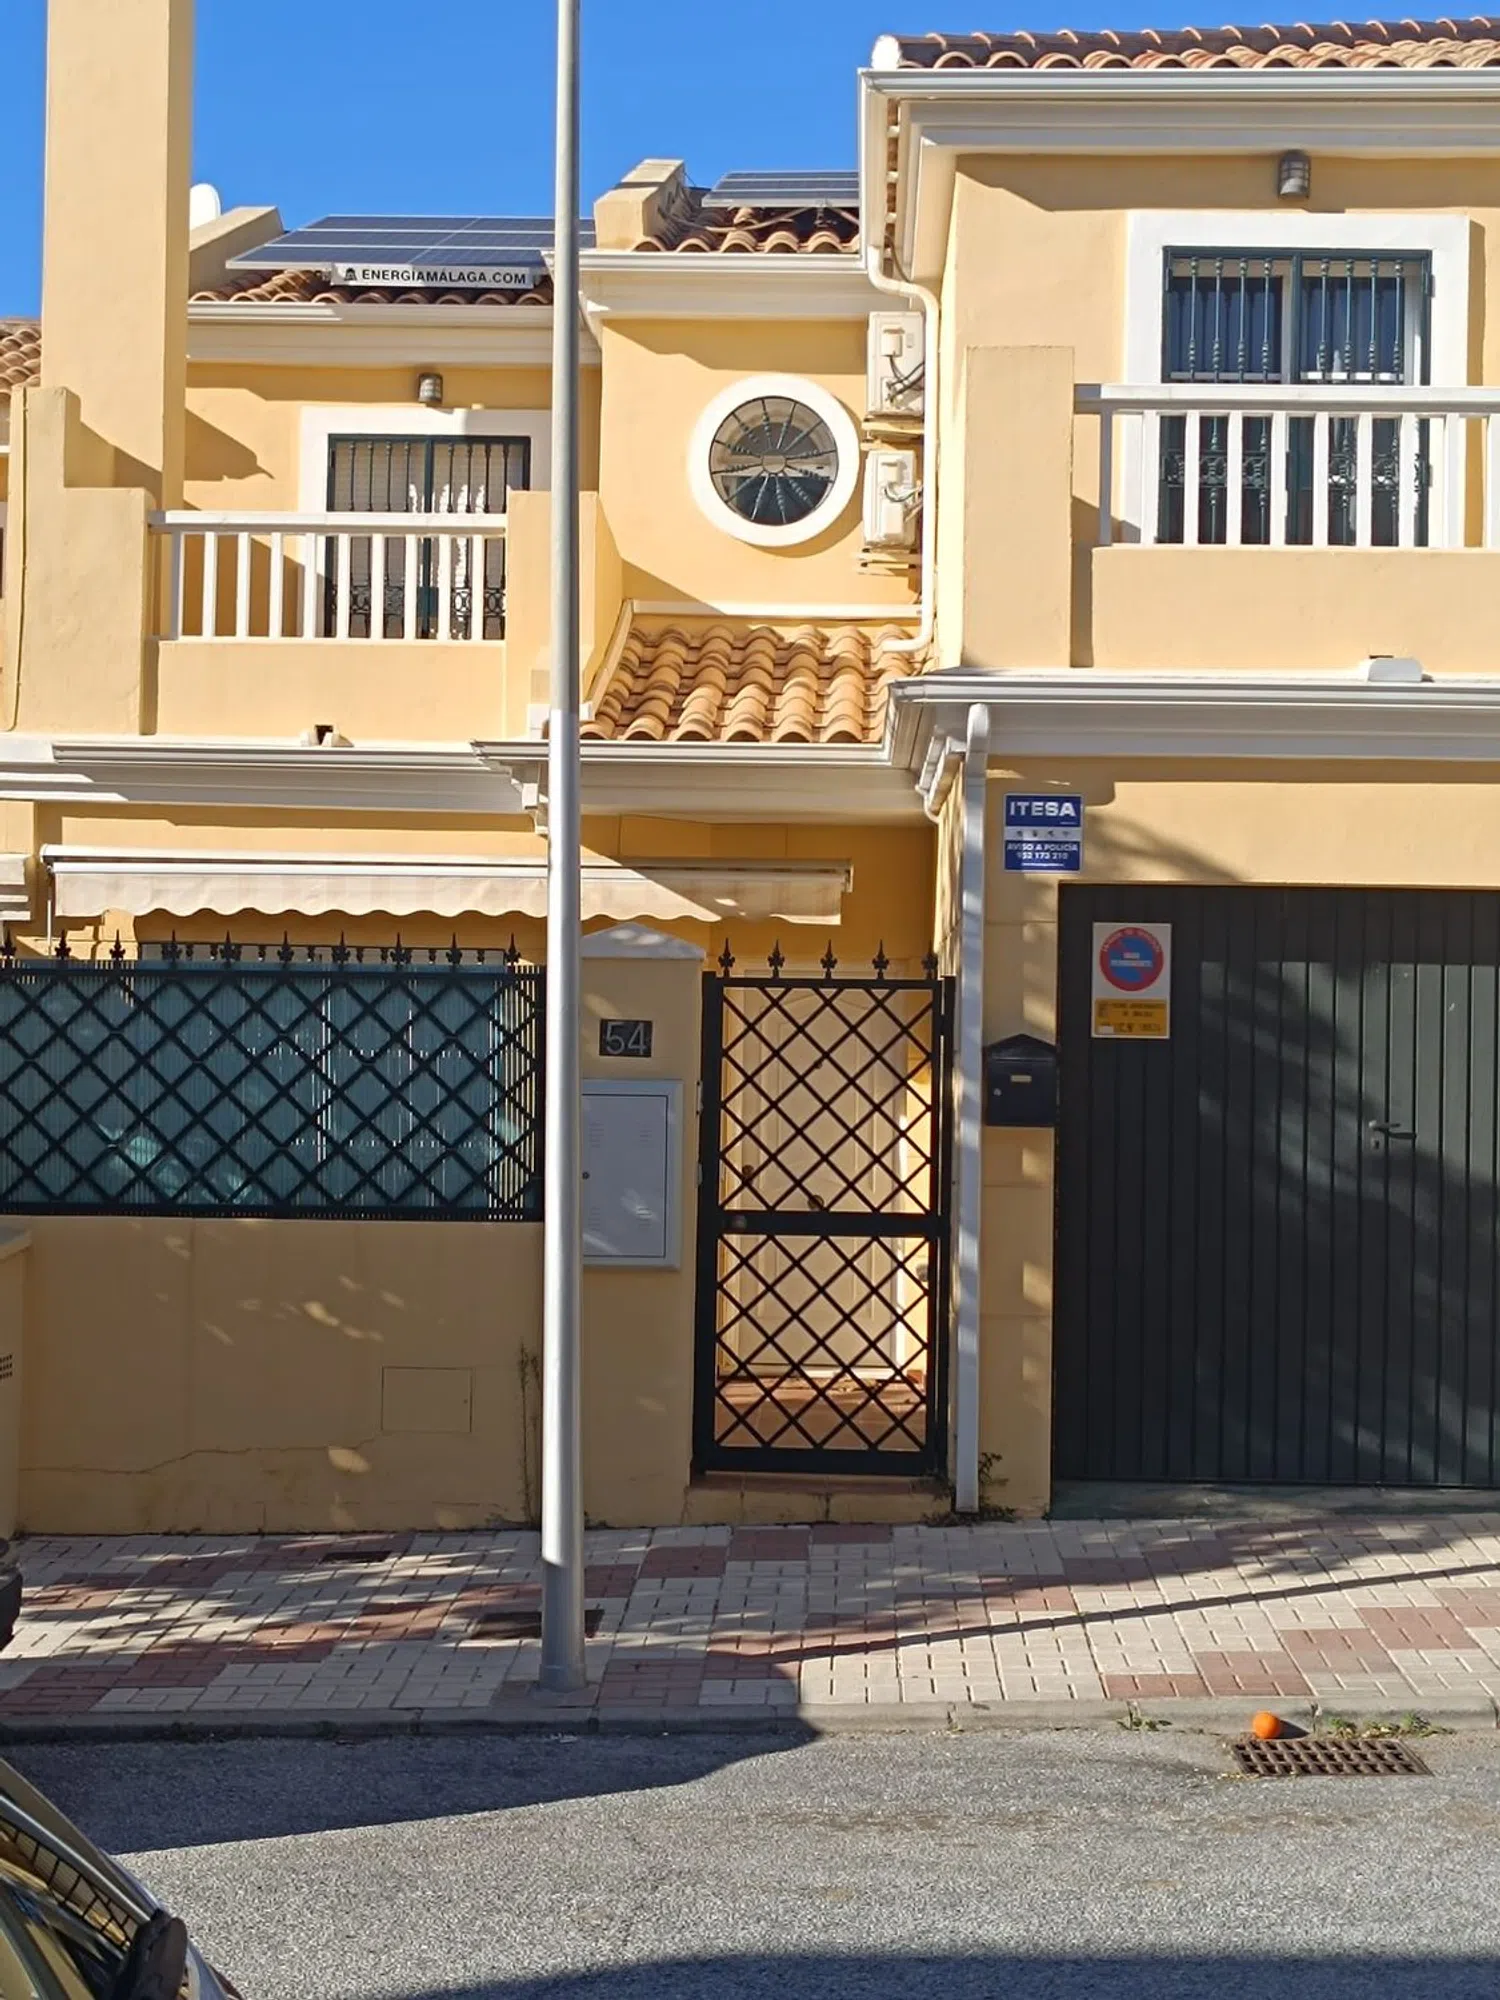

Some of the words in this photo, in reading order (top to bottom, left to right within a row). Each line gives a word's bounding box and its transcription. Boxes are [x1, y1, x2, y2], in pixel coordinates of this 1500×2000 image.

[1009, 801, 1077, 817] ITESA
[1035, 842, 1043, 851] A
[606, 1022, 648, 1055] 54
